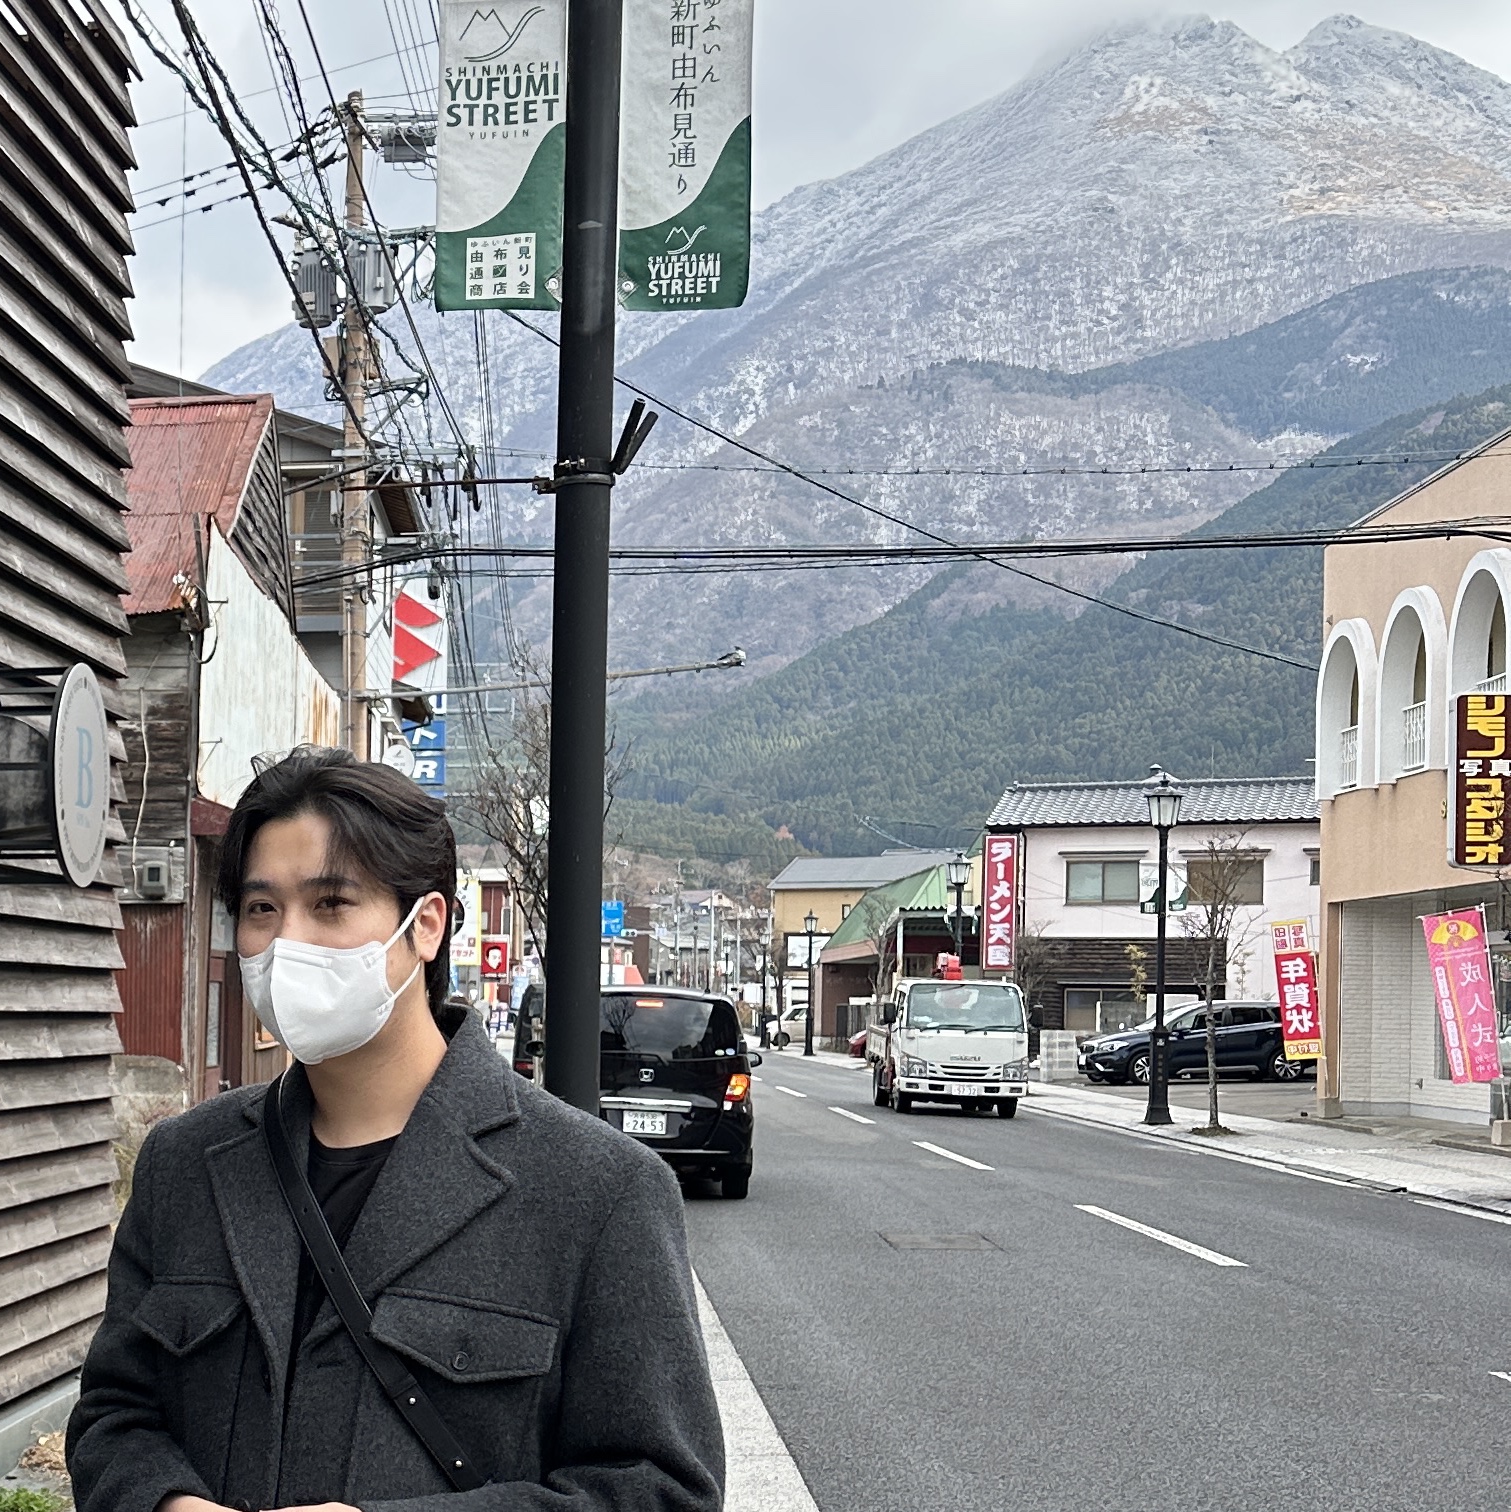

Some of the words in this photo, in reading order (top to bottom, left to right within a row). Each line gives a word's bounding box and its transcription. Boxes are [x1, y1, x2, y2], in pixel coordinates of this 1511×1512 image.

[445, 61, 559, 78] SHINMACHI
[445, 73, 559, 102] YUFUMI
[668, 0, 700, 195] 新町由布見通り
[446, 98, 560, 128] STREET
[468, 129, 529, 140] YUFUIN
[470, 246, 531, 263] 由布見
[648, 253, 721, 266] SHINMACHI
[648, 261, 721, 279] YUFUMI
[469, 281, 531, 297] 商店会
[648, 277, 721, 297] STREET
[74, 726, 94, 810] B
[412, 760, 438, 779] R
[1459, 759, 1511, 777] 写真
